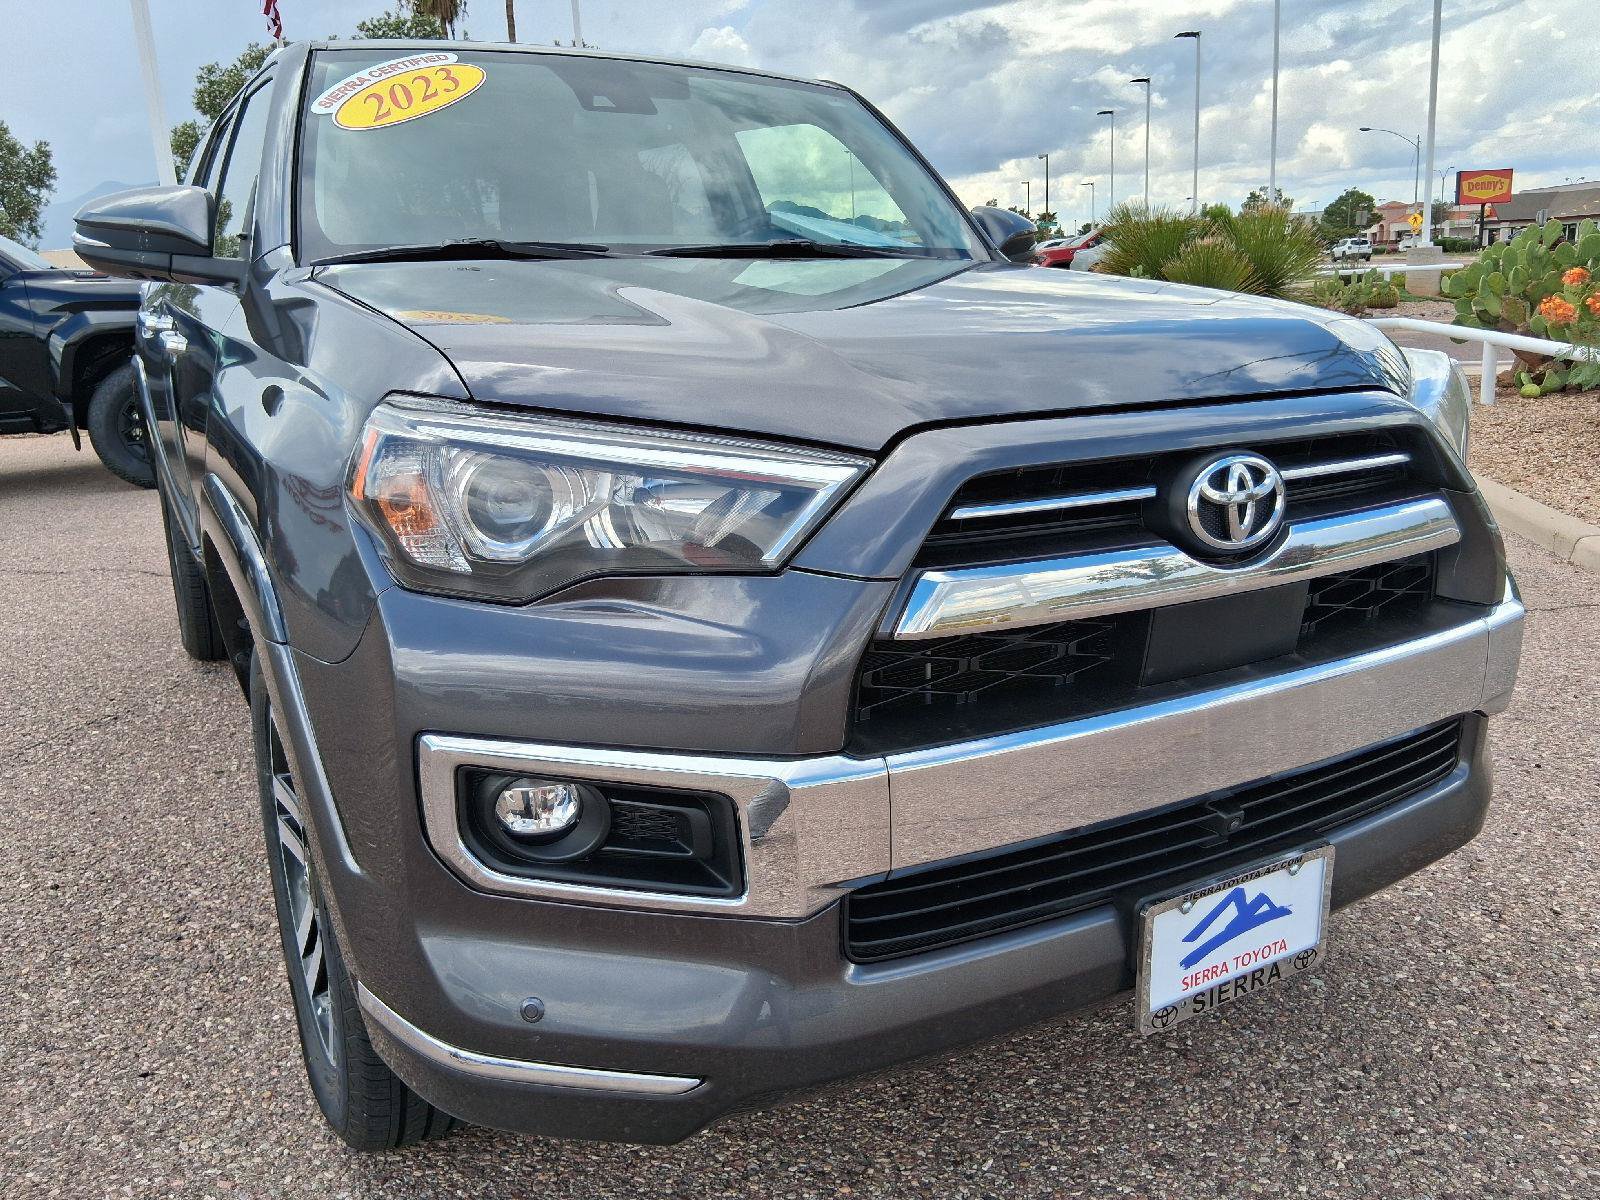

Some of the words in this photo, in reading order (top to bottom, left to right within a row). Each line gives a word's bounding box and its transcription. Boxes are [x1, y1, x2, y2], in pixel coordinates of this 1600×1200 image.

[318, 76, 371, 109] SIERRA
[368, 54, 449, 78] CERTIFIED
[363, 67, 460, 123] 2023
[1467, 179, 1505, 193] Denny's
[1183, 855, 1304, 903] SIERRATOYOTA-AZ.COM
[1181, 961, 1229, 991] SIERRA
[1233, 938, 1288, 970] TOYOTA
[1192, 962, 1281, 1014] SIERRA
